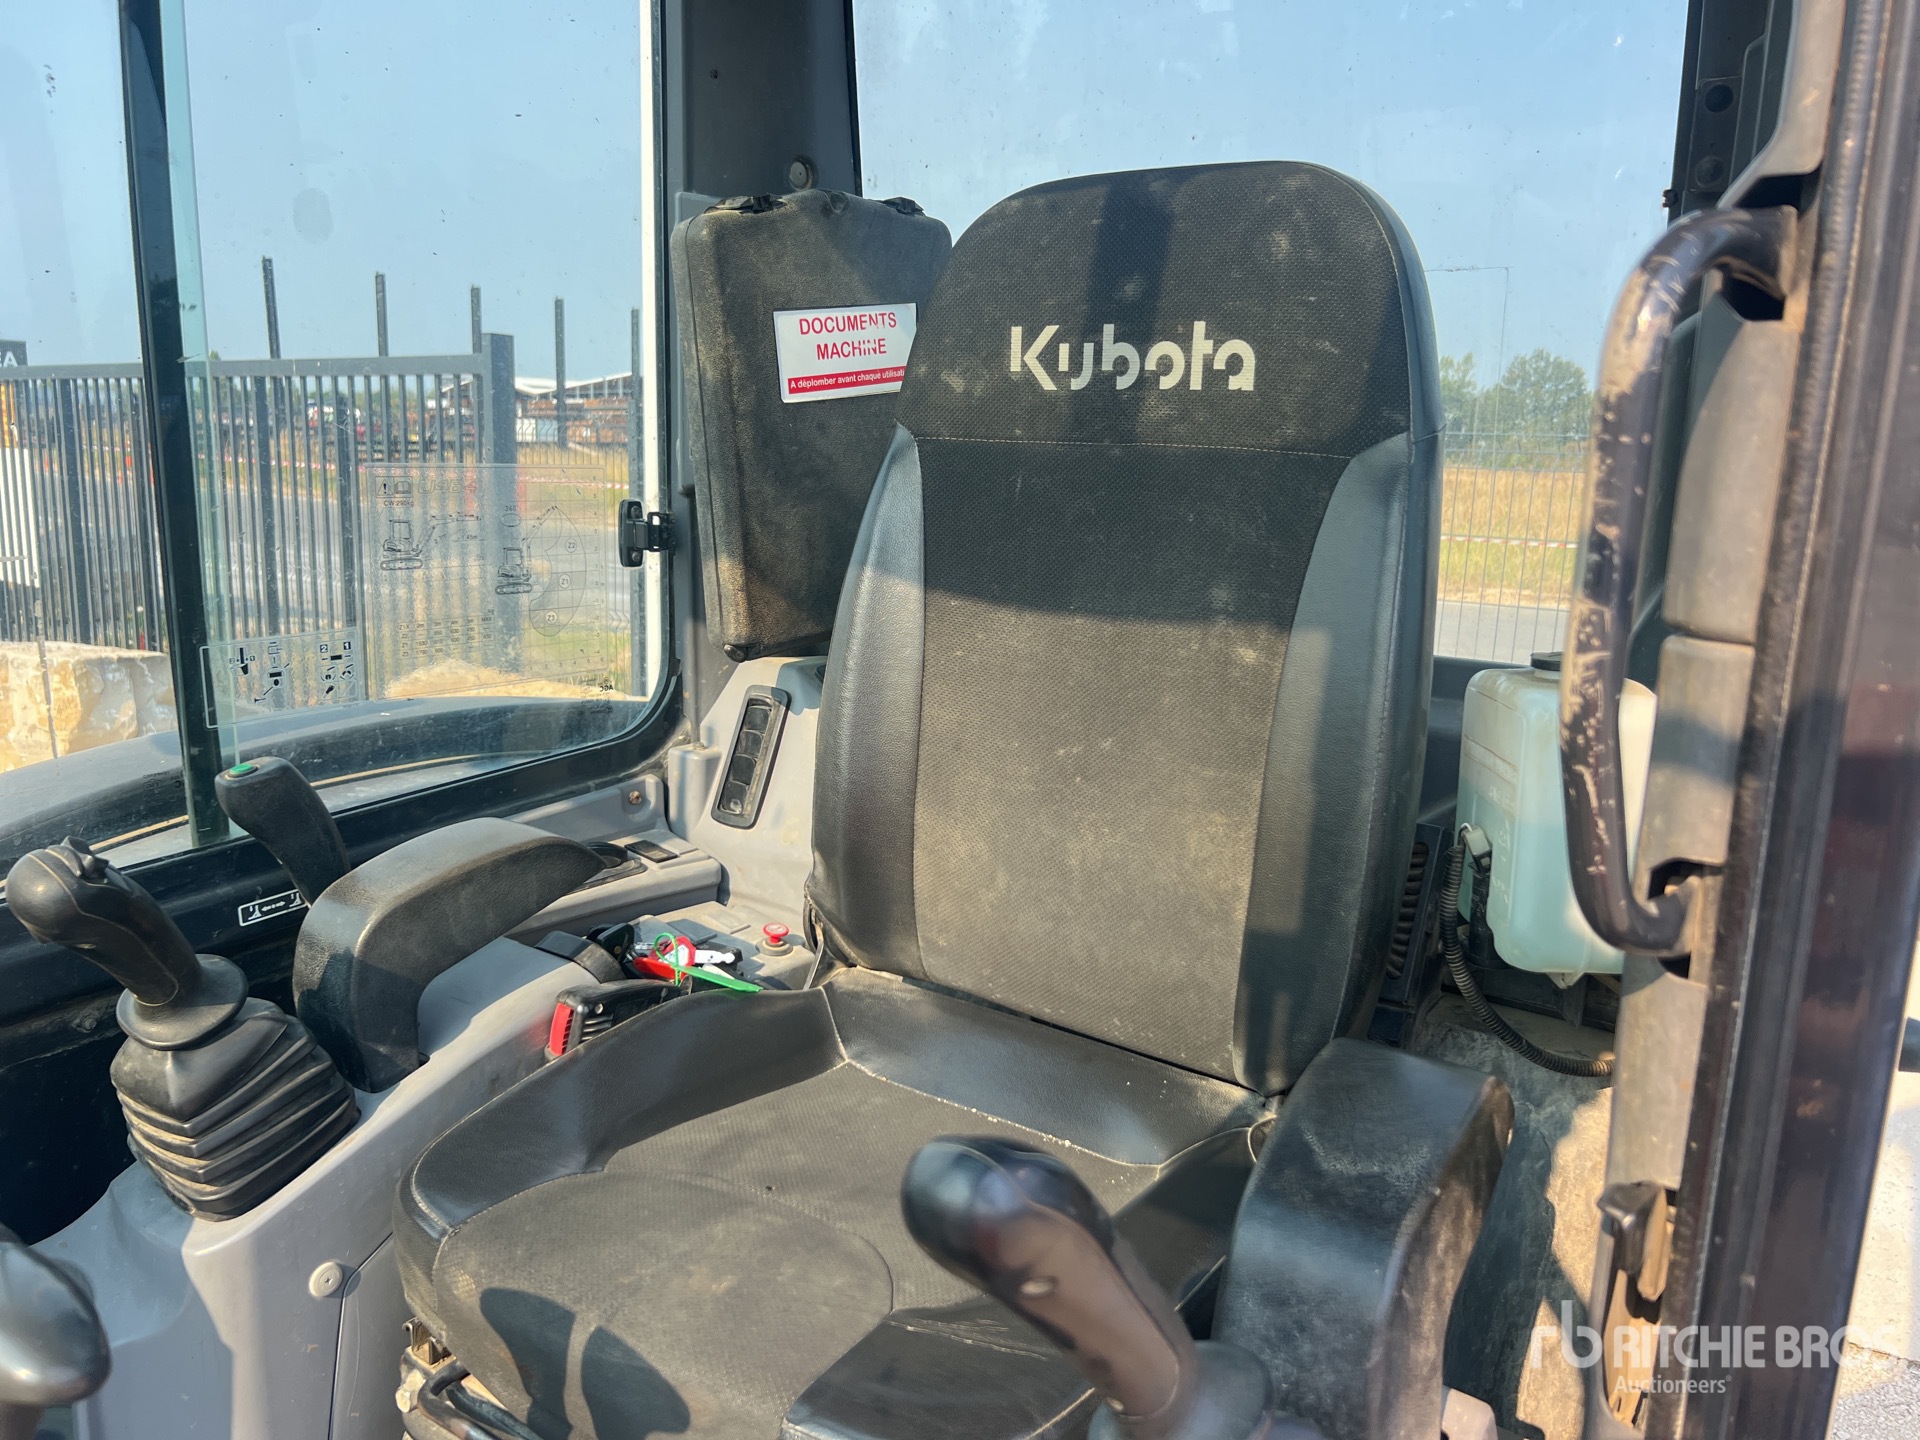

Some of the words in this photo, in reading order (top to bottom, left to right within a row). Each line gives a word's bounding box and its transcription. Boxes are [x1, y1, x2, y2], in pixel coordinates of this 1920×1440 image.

[799, 312, 897, 336] DOCUMENTS
[816, 338, 887, 360] MACHINE
[1010, 321, 1256, 391] Kubota
[790, 380, 797, 389] A
[838, 374, 857, 384] avant
[547, 614, 556, 622] Z3
